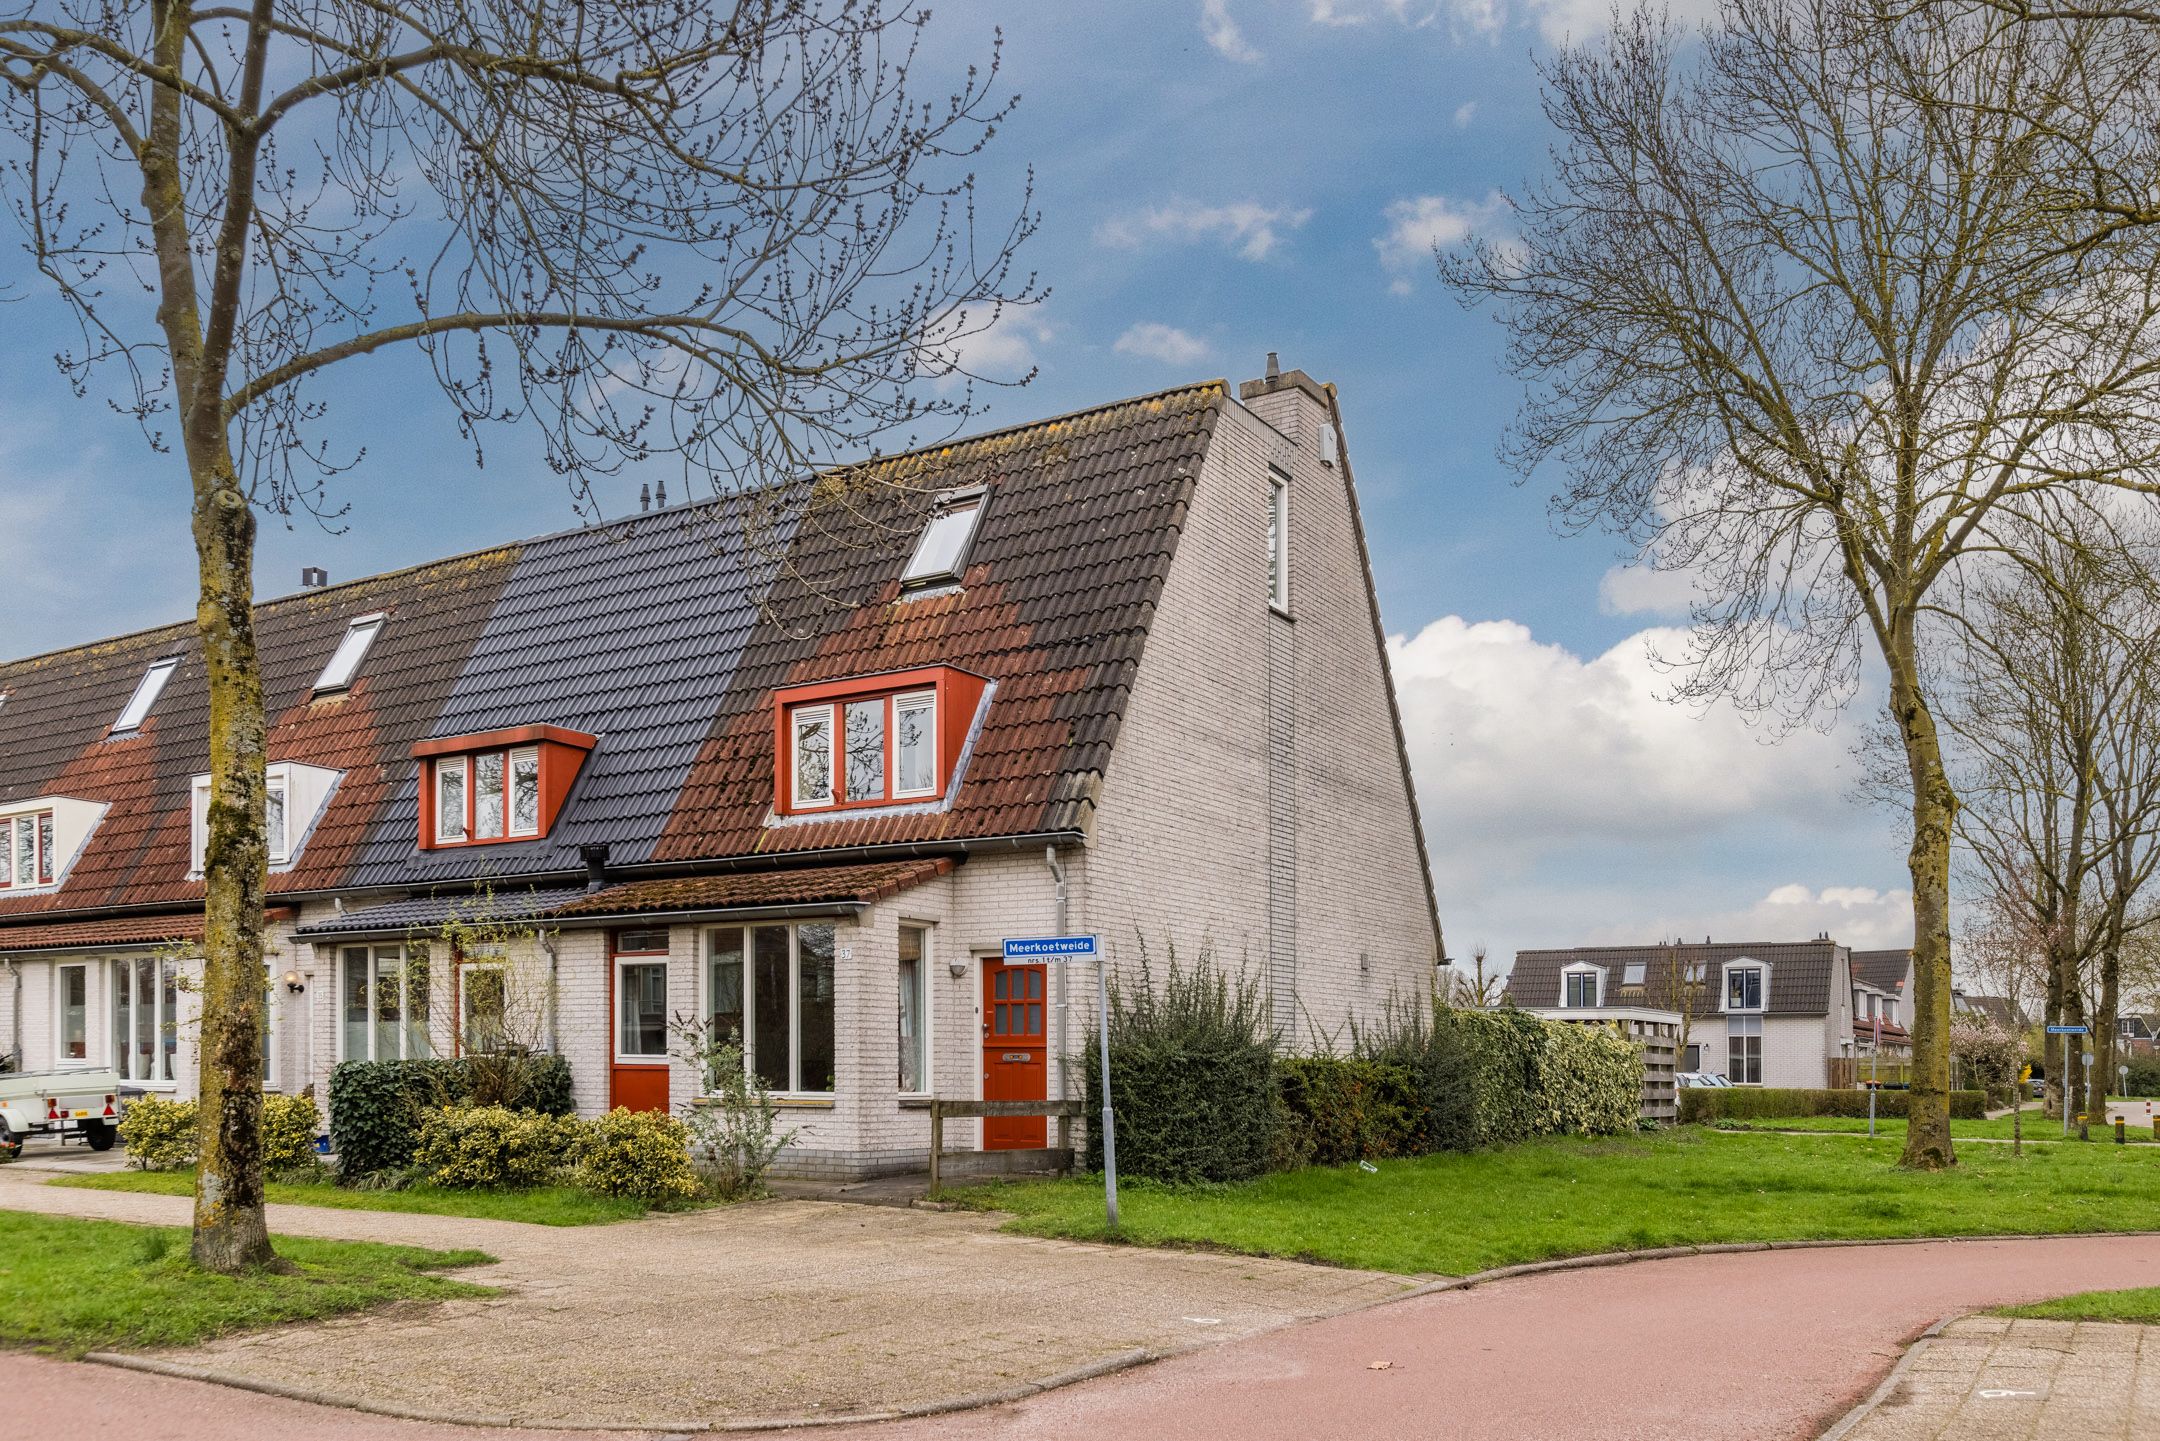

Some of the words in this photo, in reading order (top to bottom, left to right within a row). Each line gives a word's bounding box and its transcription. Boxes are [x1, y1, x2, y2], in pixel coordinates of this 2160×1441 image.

[1009, 942, 1090, 953] Meerkoetweide
[841, 949, 850, 959] 37
[1063, 955, 1073, 963] 37
